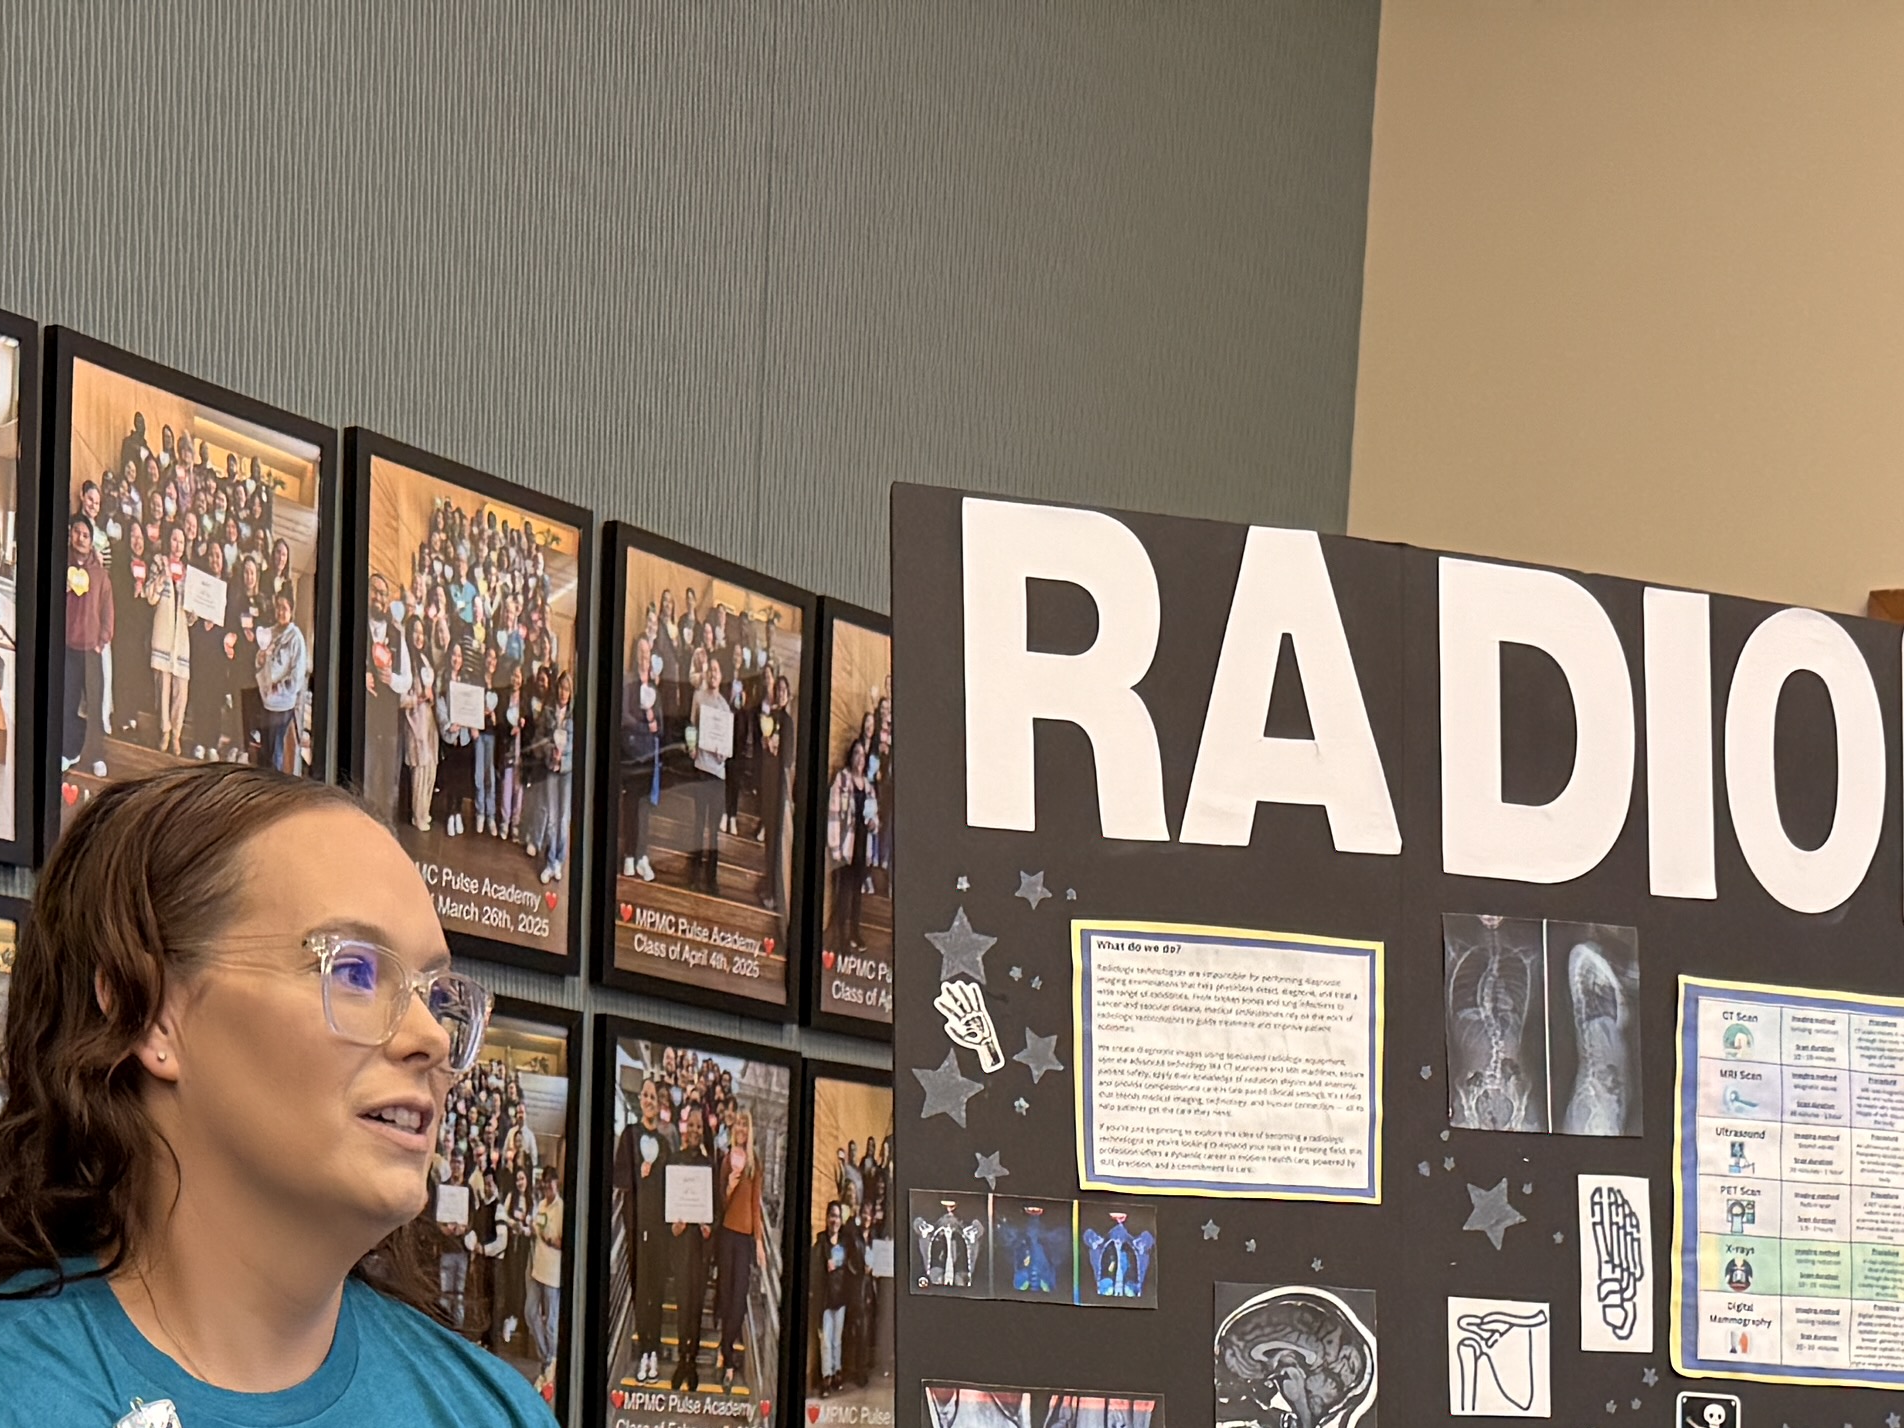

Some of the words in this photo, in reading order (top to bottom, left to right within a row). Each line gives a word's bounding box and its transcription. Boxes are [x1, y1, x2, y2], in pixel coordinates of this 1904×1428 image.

[442, 868, 479, 894] Pulse
[481, 877, 542, 913] Academy
[438, 896, 479, 922] March
[518, 914, 550, 937] 2025
[635, 907, 675, 934] MPMC
[678, 919, 709, 943] Pulse
[710, 926, 762, 958] Academy
[634, 933, 666, 958] Class
[668, 944, 680, 961] of
[681, 944, 708, 968] April
[732, 957, 760, 979] 2025
